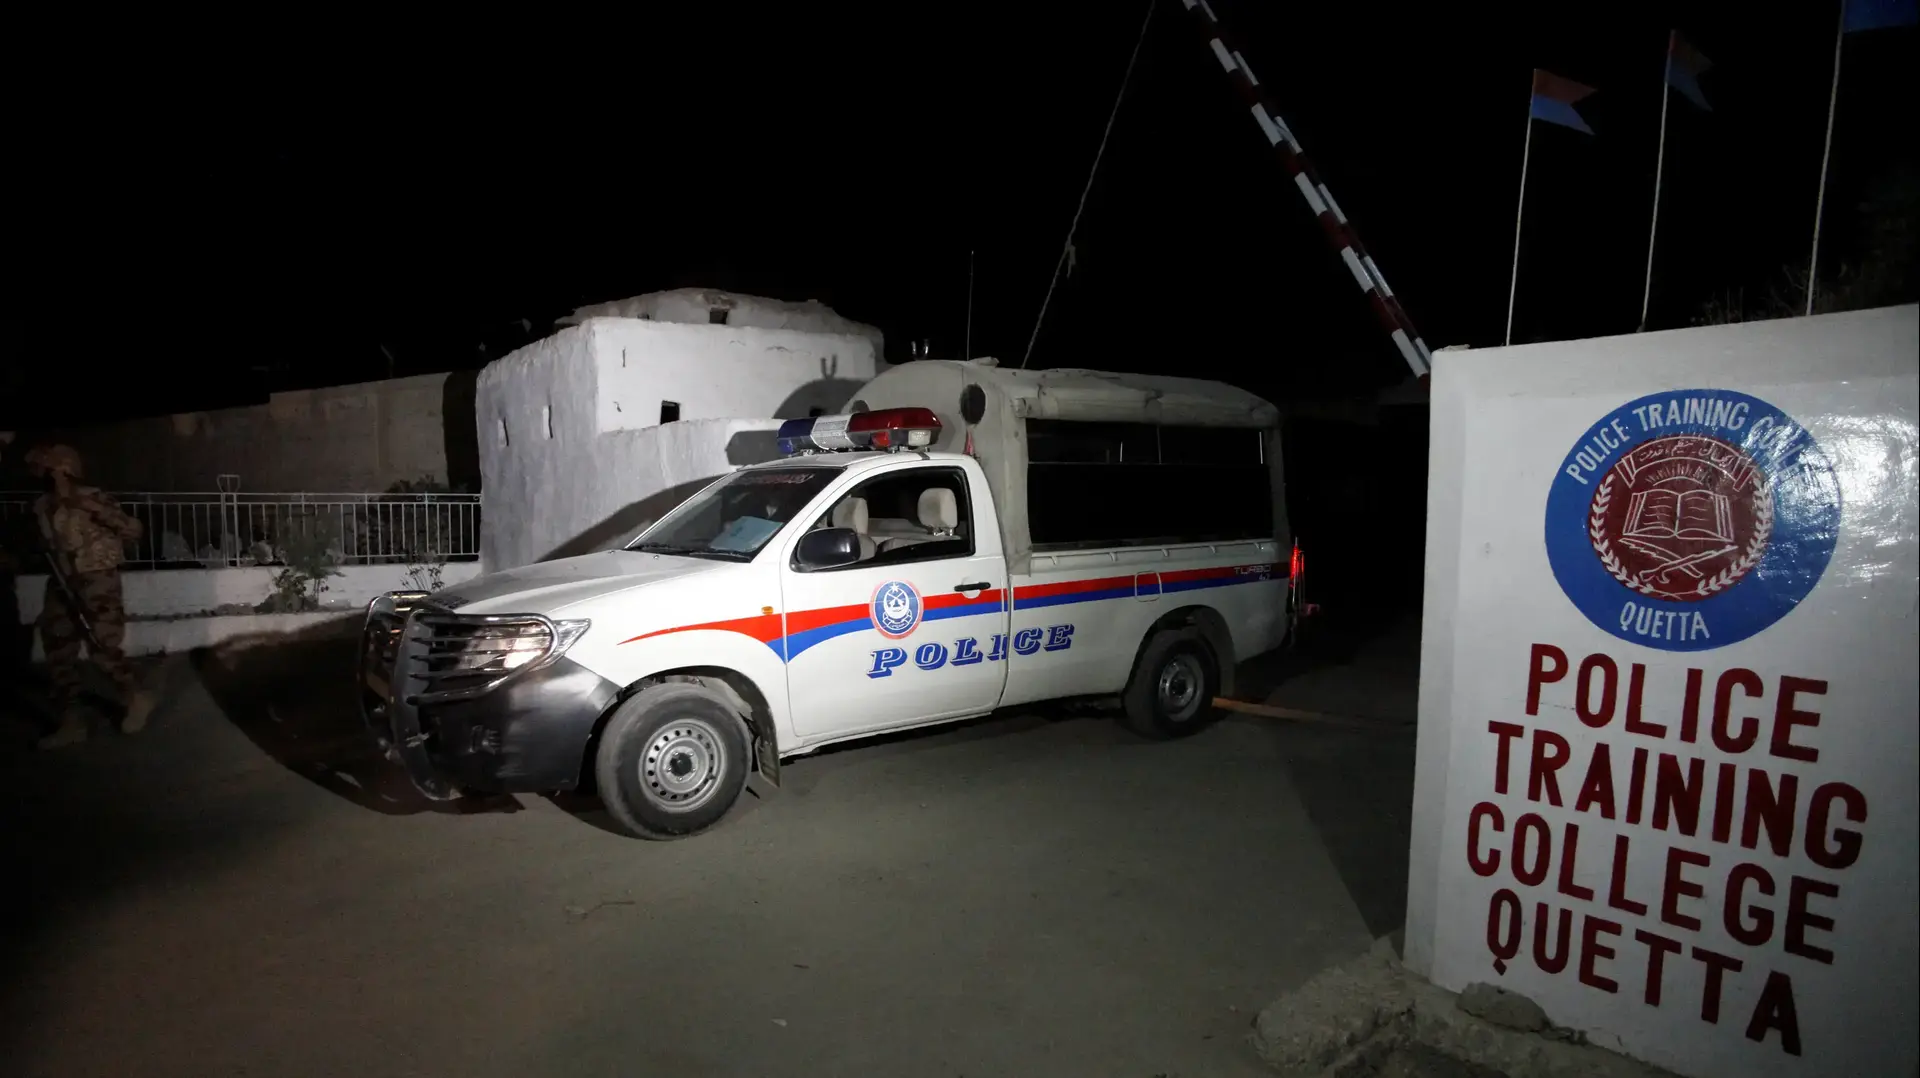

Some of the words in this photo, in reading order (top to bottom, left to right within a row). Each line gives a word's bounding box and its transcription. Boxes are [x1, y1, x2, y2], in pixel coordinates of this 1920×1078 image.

[1565, 417, 1631, 485] POLICE
[1631, 398, 1750, 432] TRAINING
[1233, 564, 1271, 576] TURBO
[1619, 600, 1711, 641] QUETTA
[866, 623, 1076, 680] POLICE
[1524, 642, 1829, 764] POLICE
[1487, 720, 1869, 870] TRAINING
[1466, 801, 1840, 965] COLLEGE
[1485, 888, 1802, 1057] QUETTA
